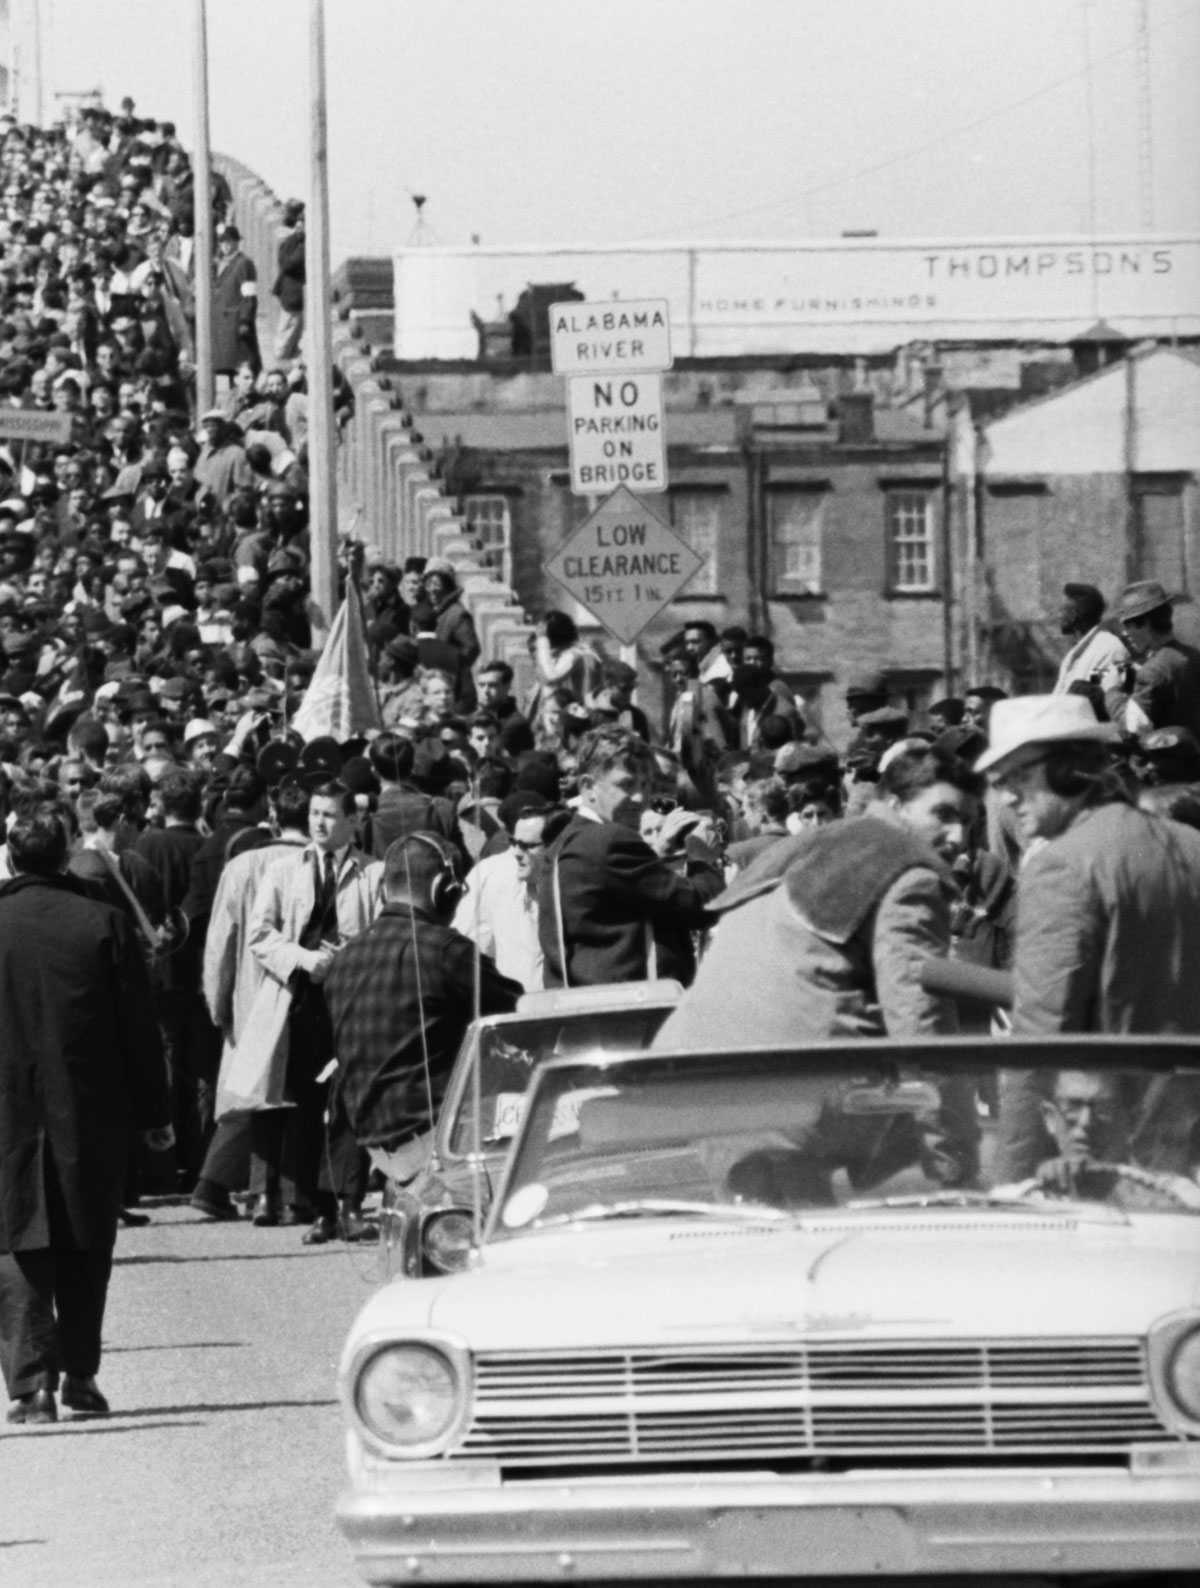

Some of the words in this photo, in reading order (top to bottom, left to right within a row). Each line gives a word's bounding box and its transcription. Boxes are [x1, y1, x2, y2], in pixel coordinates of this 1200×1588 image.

[700, 297, 764, 311] HOME
[774, 294, 936, 311] FURNISHINGS
[556, 311, 664, 333] ALABAMA
[576, 340, 645, 359] RIVER
[594, 381, 639, 408] NO
[574, 414, 659, 434] PARKING
[603, 440, 633, 457] ON
[580, 462, 657, 483] BRIDGE
[596, 523, 647, 547] LOW
[562, 553, 681, 578] CLEARANCE
